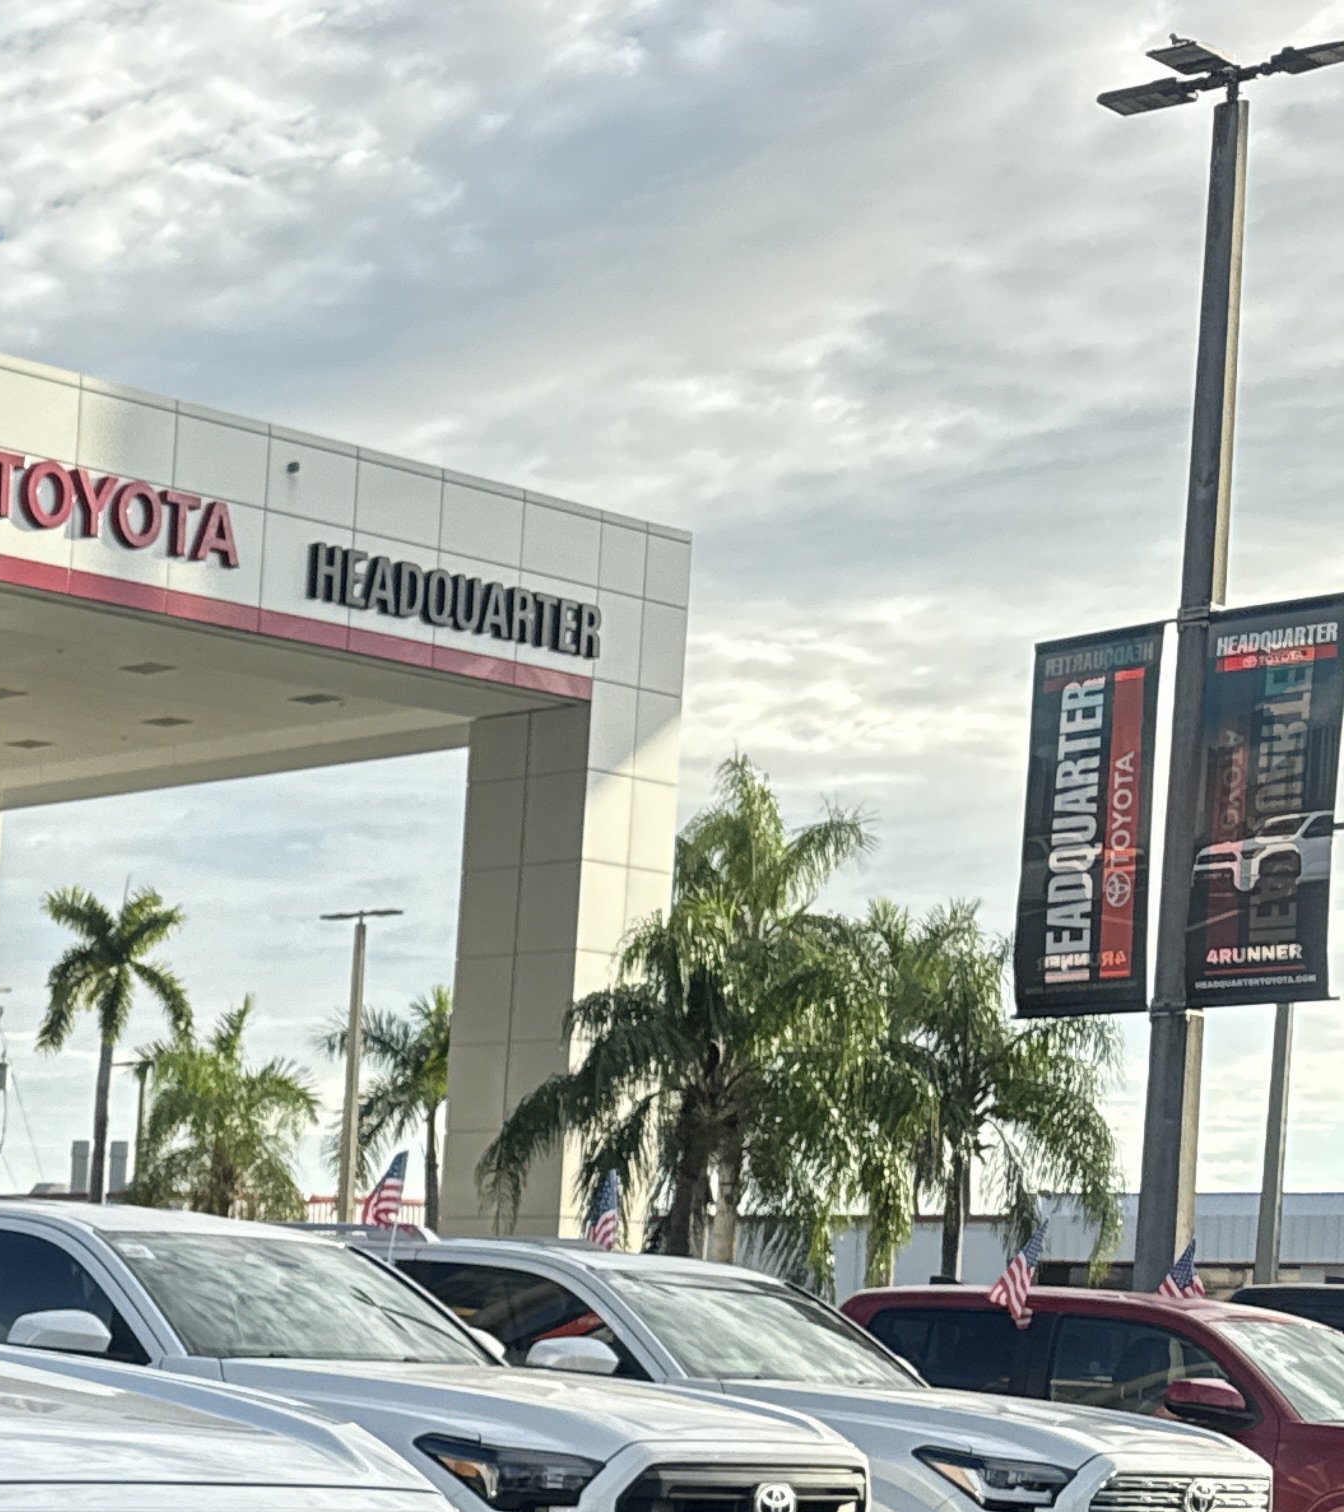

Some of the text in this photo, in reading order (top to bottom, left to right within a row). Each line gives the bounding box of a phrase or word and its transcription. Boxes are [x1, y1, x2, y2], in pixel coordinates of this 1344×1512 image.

[306, 542, 602, 659] HEADQUARTER
[1216, 622, 1338, 656] HEADQUARTER
[1258, 650, 1305, 667] TOYOTA
[1045, 675, 1106, 984] HEADQUARTER
[1109, 751, 1134, 864] TOYOTA
[1205, 943, 1303, 965] 4RUNNER
